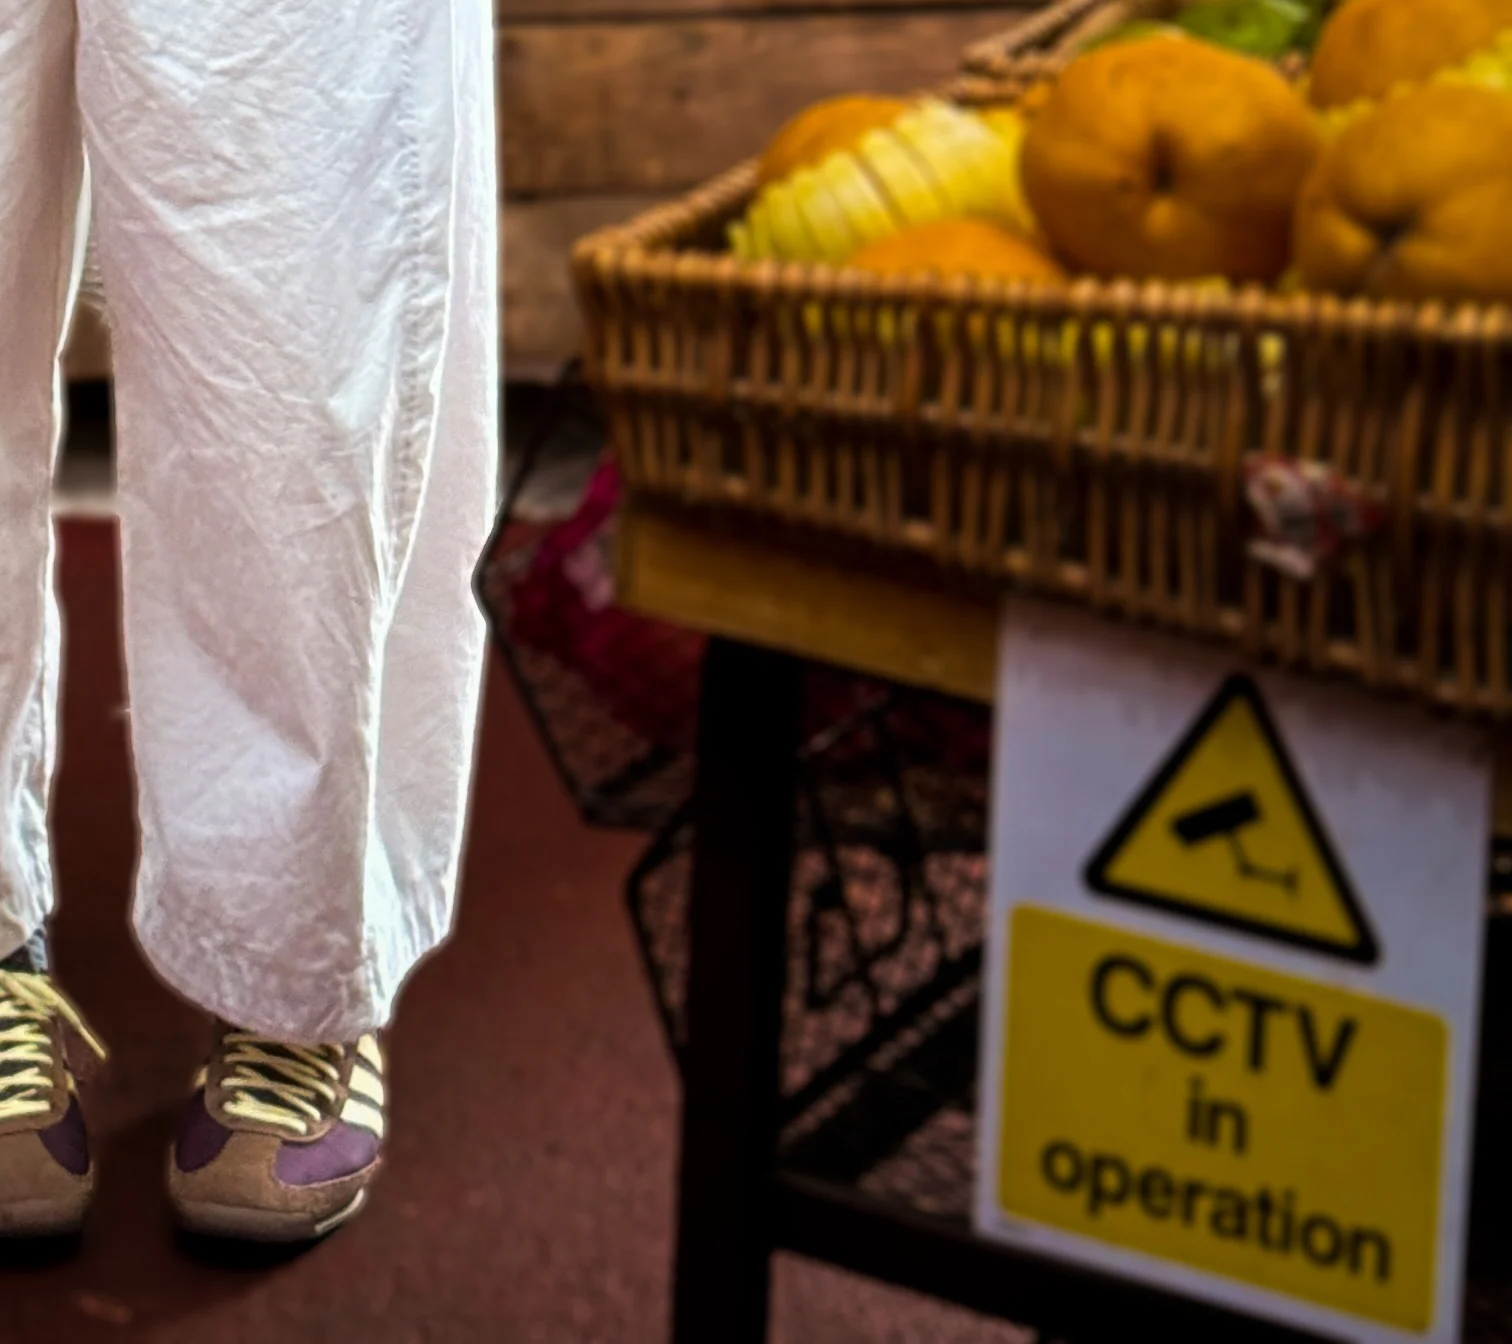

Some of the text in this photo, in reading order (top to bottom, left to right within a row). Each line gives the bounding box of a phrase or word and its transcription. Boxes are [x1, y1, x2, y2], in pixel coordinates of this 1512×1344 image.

[1089, 952, 1359, 1093] CCTV
[1186, 1076, 1249, 1156] in
[1039, 1139, 1393, 1283] operation
